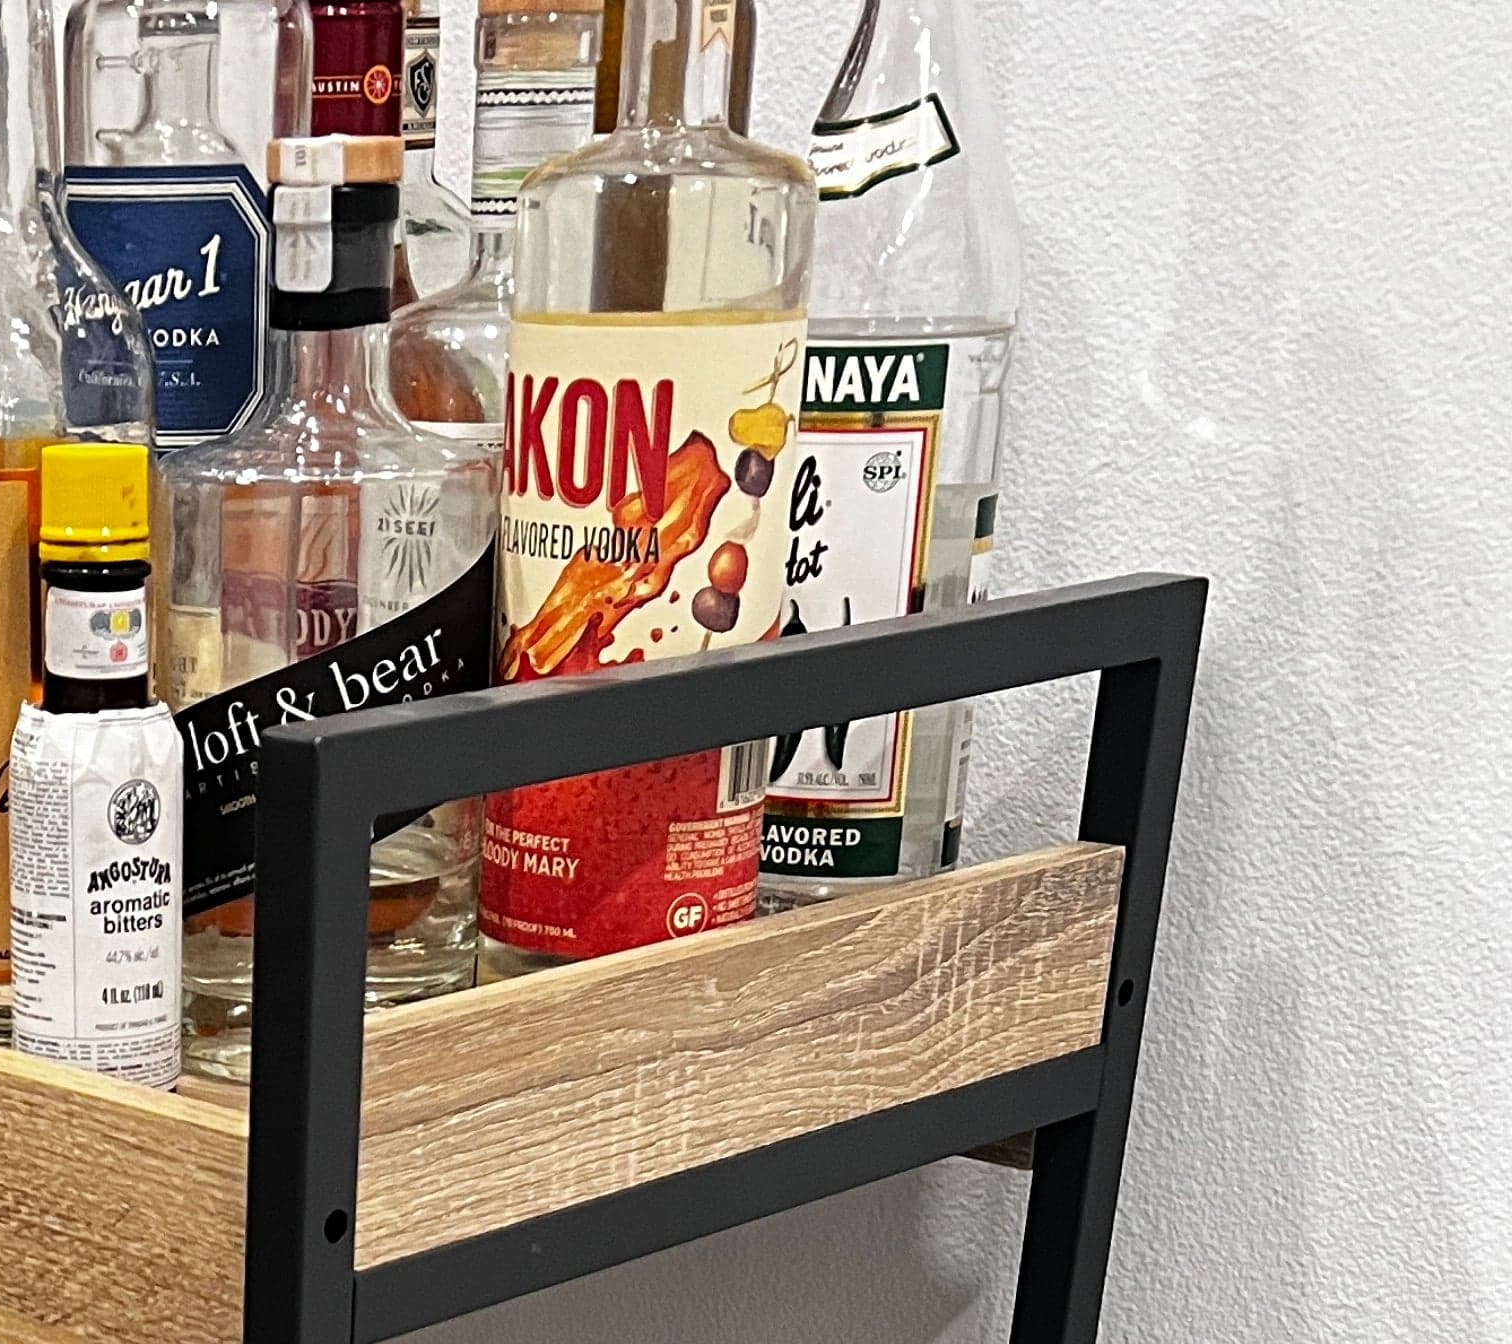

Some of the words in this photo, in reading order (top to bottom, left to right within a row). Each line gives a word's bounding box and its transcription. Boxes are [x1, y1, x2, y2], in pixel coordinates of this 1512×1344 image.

[198, 234, 221, 297] 1
[148, 328, 221, 347] ODKA
[503, 515, 574, 561] FLAVORED
[583, 525, 660, 564] VODKA
[188, 701, 262, 772] loft
[275, 687, 316, 726] &
[328, 628, 442, 712] bear
[512, 830, 571, 853] PERFECT
[761, 824, 861, 847] AVORED
[482, 836, 519, 870] LOODY
[523, 852, 580, 880] MARY
[760, 845, 835, 867] VODKA
[87, 856, 171, 894] ANGOSTURA
[90, 889, 170, 916] aromatic
[103, 913, 163, 934] bitters
[673, 905, 703, 929] GF
